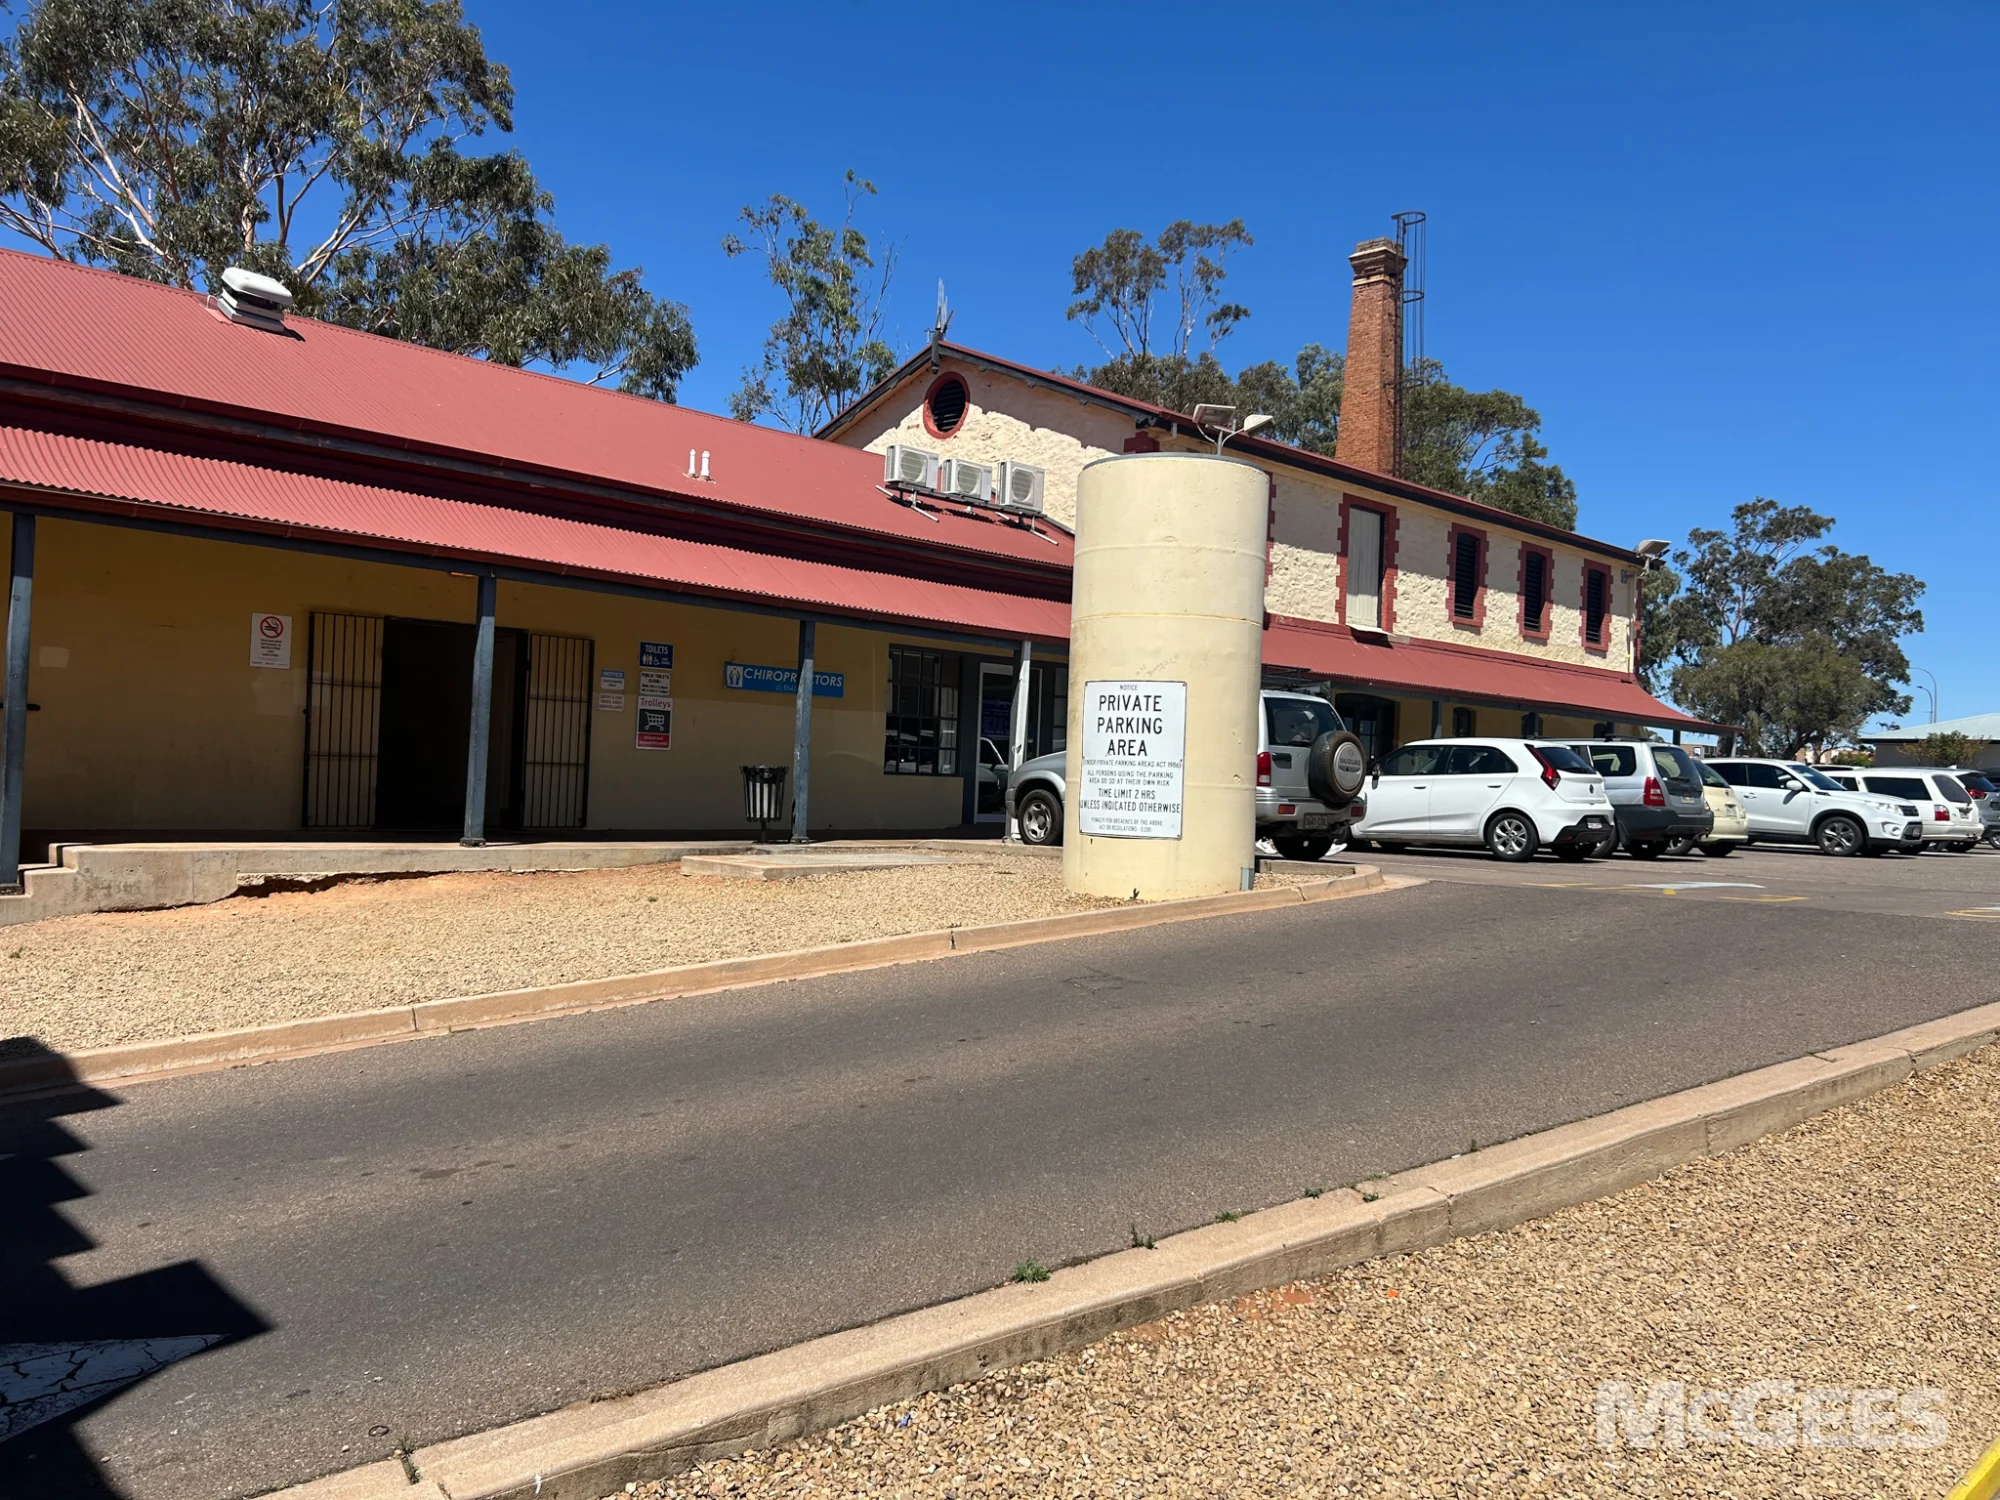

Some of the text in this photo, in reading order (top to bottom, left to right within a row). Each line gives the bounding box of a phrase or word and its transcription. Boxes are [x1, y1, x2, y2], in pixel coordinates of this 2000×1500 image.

[645, 644, 669, 655] TOILETS
[743, 668, 843, 687] CHIROPRTORS
[640, 698, 671, 709] Trolleys
[1099, 695, 1162, 712] PRIVATE
[1097, 717, 1163, 734] PARKING
[1107, 739, 1148, 756] AREA
[1098, 788, 1156, 800] TIME LIMIT 2 HRS
[1080, 800, 1181, 814] UNLESS INDICATED OTHERWISE
